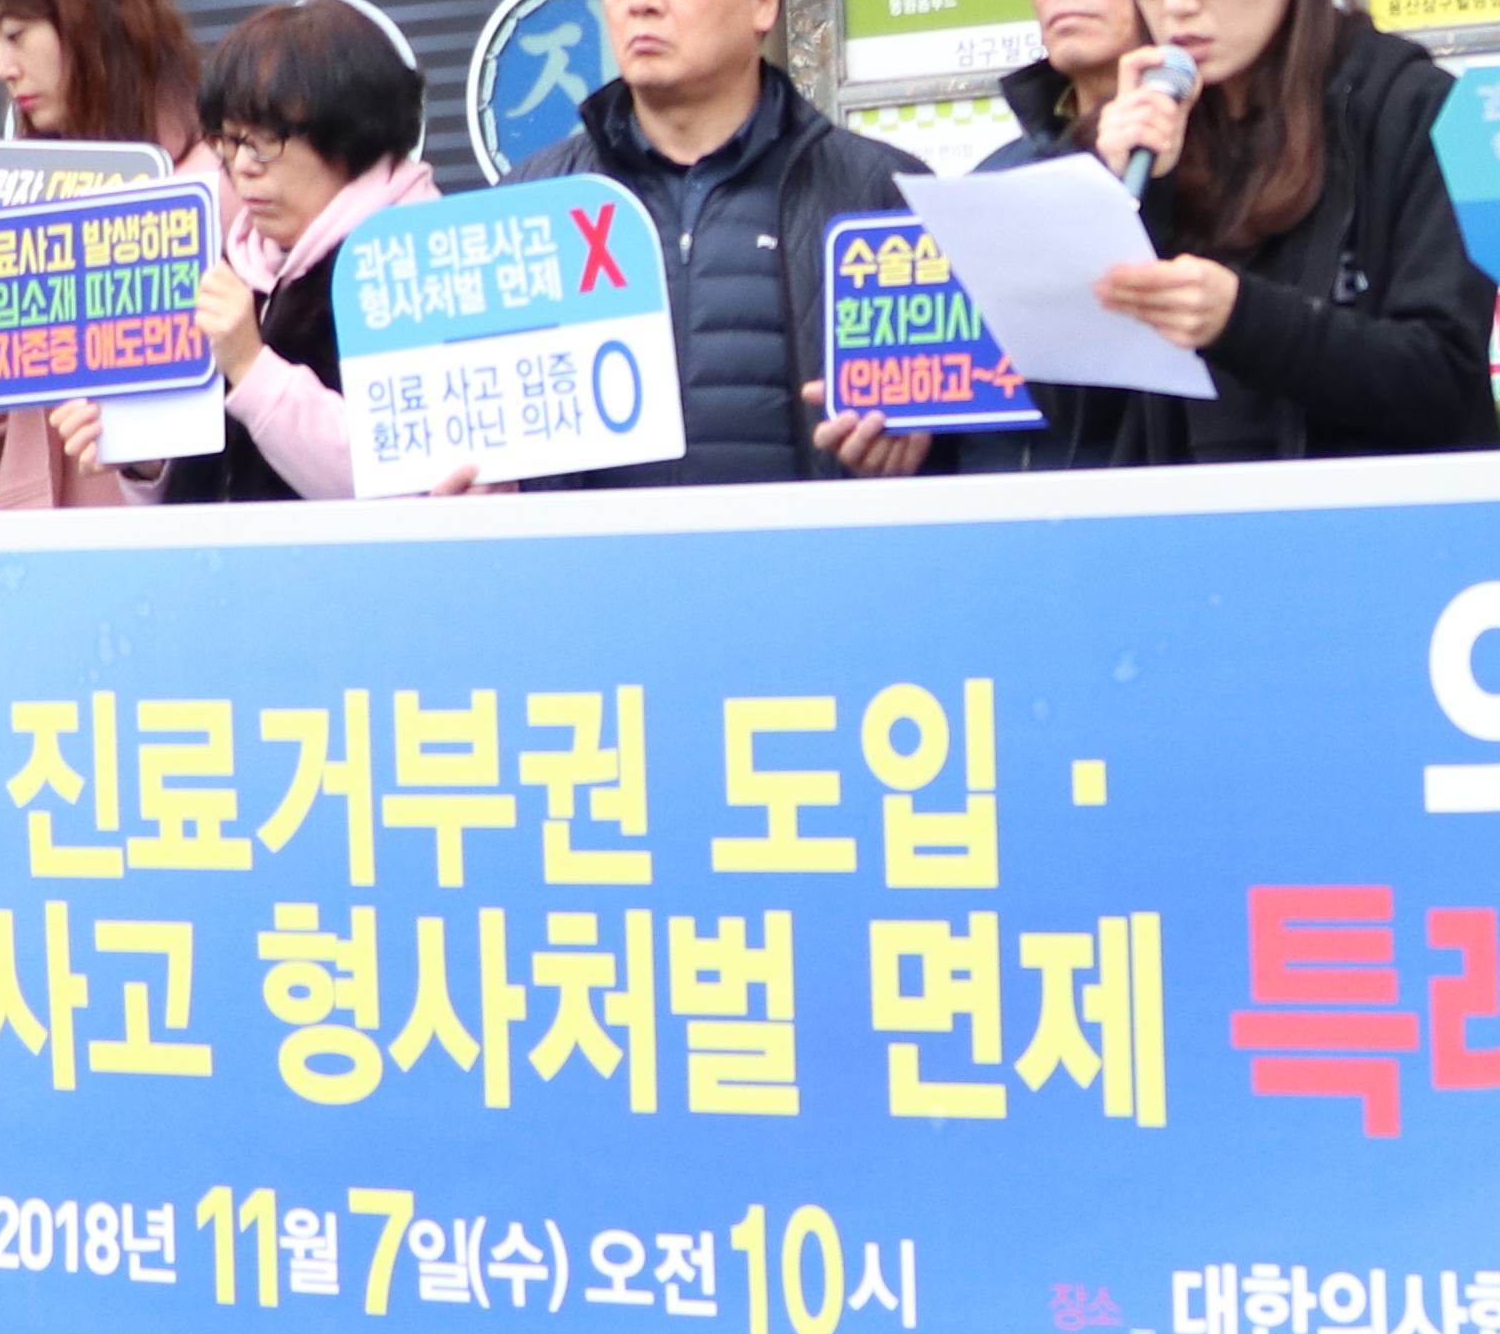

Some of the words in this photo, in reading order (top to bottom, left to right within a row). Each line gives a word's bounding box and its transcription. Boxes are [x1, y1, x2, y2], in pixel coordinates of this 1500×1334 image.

[83, 207, 199, 268] 발생하면
[353, 233, 419, 283] 과실
[428, 215, 558, 267] 의료사고
[839, 232, 952, 289] 수술실
[85, 259, 201, 319] 따지기전
[357, 269, 487, 331] 형사처벌
[496, 257, 564, 309] 면제
[84, 312, 203, 371] 애도먼저
[367, 375, 429, 417] 의료
[442, 364, 503, 406] 사고
[516, 351, 578, 399] 입증
[372, 416, 434, 463] 환자
[445, 407, 508, 450] 아닌
[521, 395, 583, 440] 의사
[7, 686, 652, 889] 진료거부권
[712, 677, 999, 888] 도입
[258, 902, 800, 1116] 형사처벌
[869, 911, 1167, 1127] 면제
[583, 1228, 718, 1317] 오전
